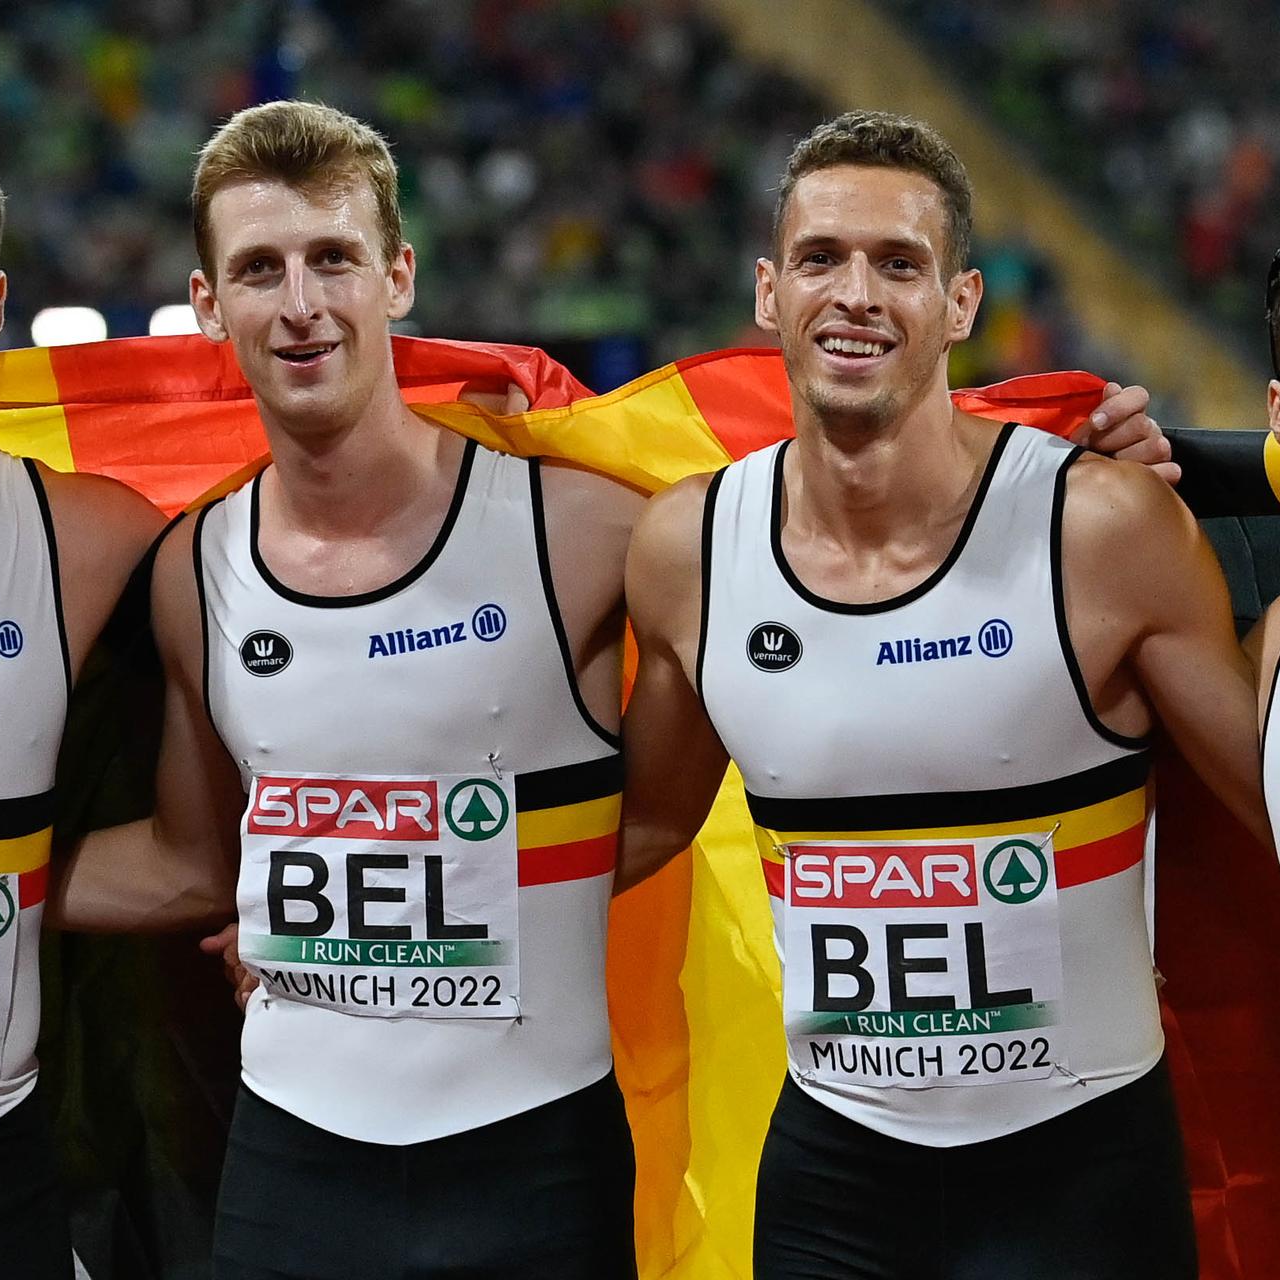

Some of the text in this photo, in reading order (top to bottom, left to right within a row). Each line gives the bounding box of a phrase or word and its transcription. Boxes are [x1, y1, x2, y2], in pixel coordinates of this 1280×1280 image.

[368, 621, 467, 659] Allianz
[753, 651, 793, 662] vermarc
[876, 634, 973, 666] Allianz
[247, 656, 284, 667] vermarc
[251, 786, 433, 833] SPAR
[266, 850, 488, 940] BEL
[794, 854, 972, 899] SPAR
[300, 943, 306, 960] I
[313, 943, 361, 963] RUN
[809, 921, 1033, 1013] BEL
[260, 968, 502, 1007] MUNICH 2022
[845, 1015, 851, 1031] I
[858, 1015, 905, 1035] RUN
[809, 1037, 1051, 1078] MUNICH 2022
